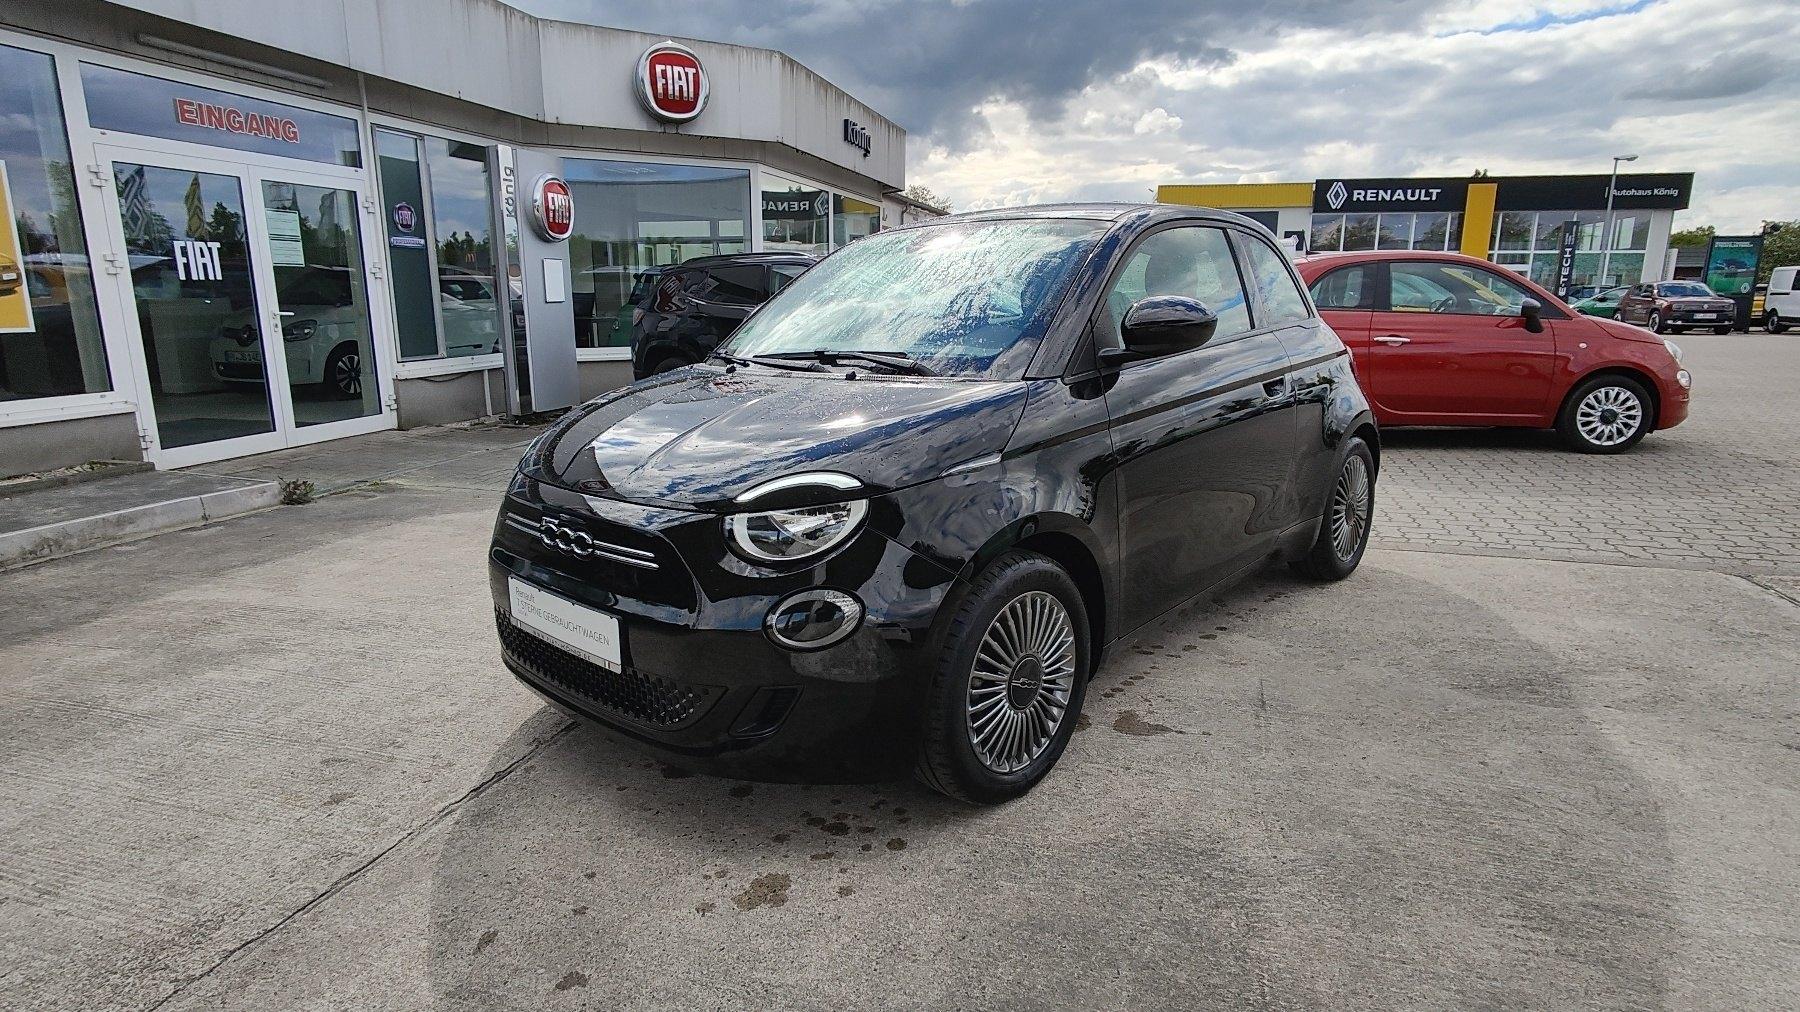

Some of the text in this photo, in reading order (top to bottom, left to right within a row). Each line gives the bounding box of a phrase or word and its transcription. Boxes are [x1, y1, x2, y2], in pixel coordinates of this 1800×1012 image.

[655, 64, 697, 101] FIAT
[173, 98, 299, 143] EINGANG
[844, 119, 871, 157] König
[502, 166, 516, 218] König
[547, 192, 570, 224] FIAT
[1352, 189, 1441, 201] RENAULT
[1653, 187, 1679, 197] König
[173, 241, 222, 281] FIAT
[541, 516, 593, 556] 500
